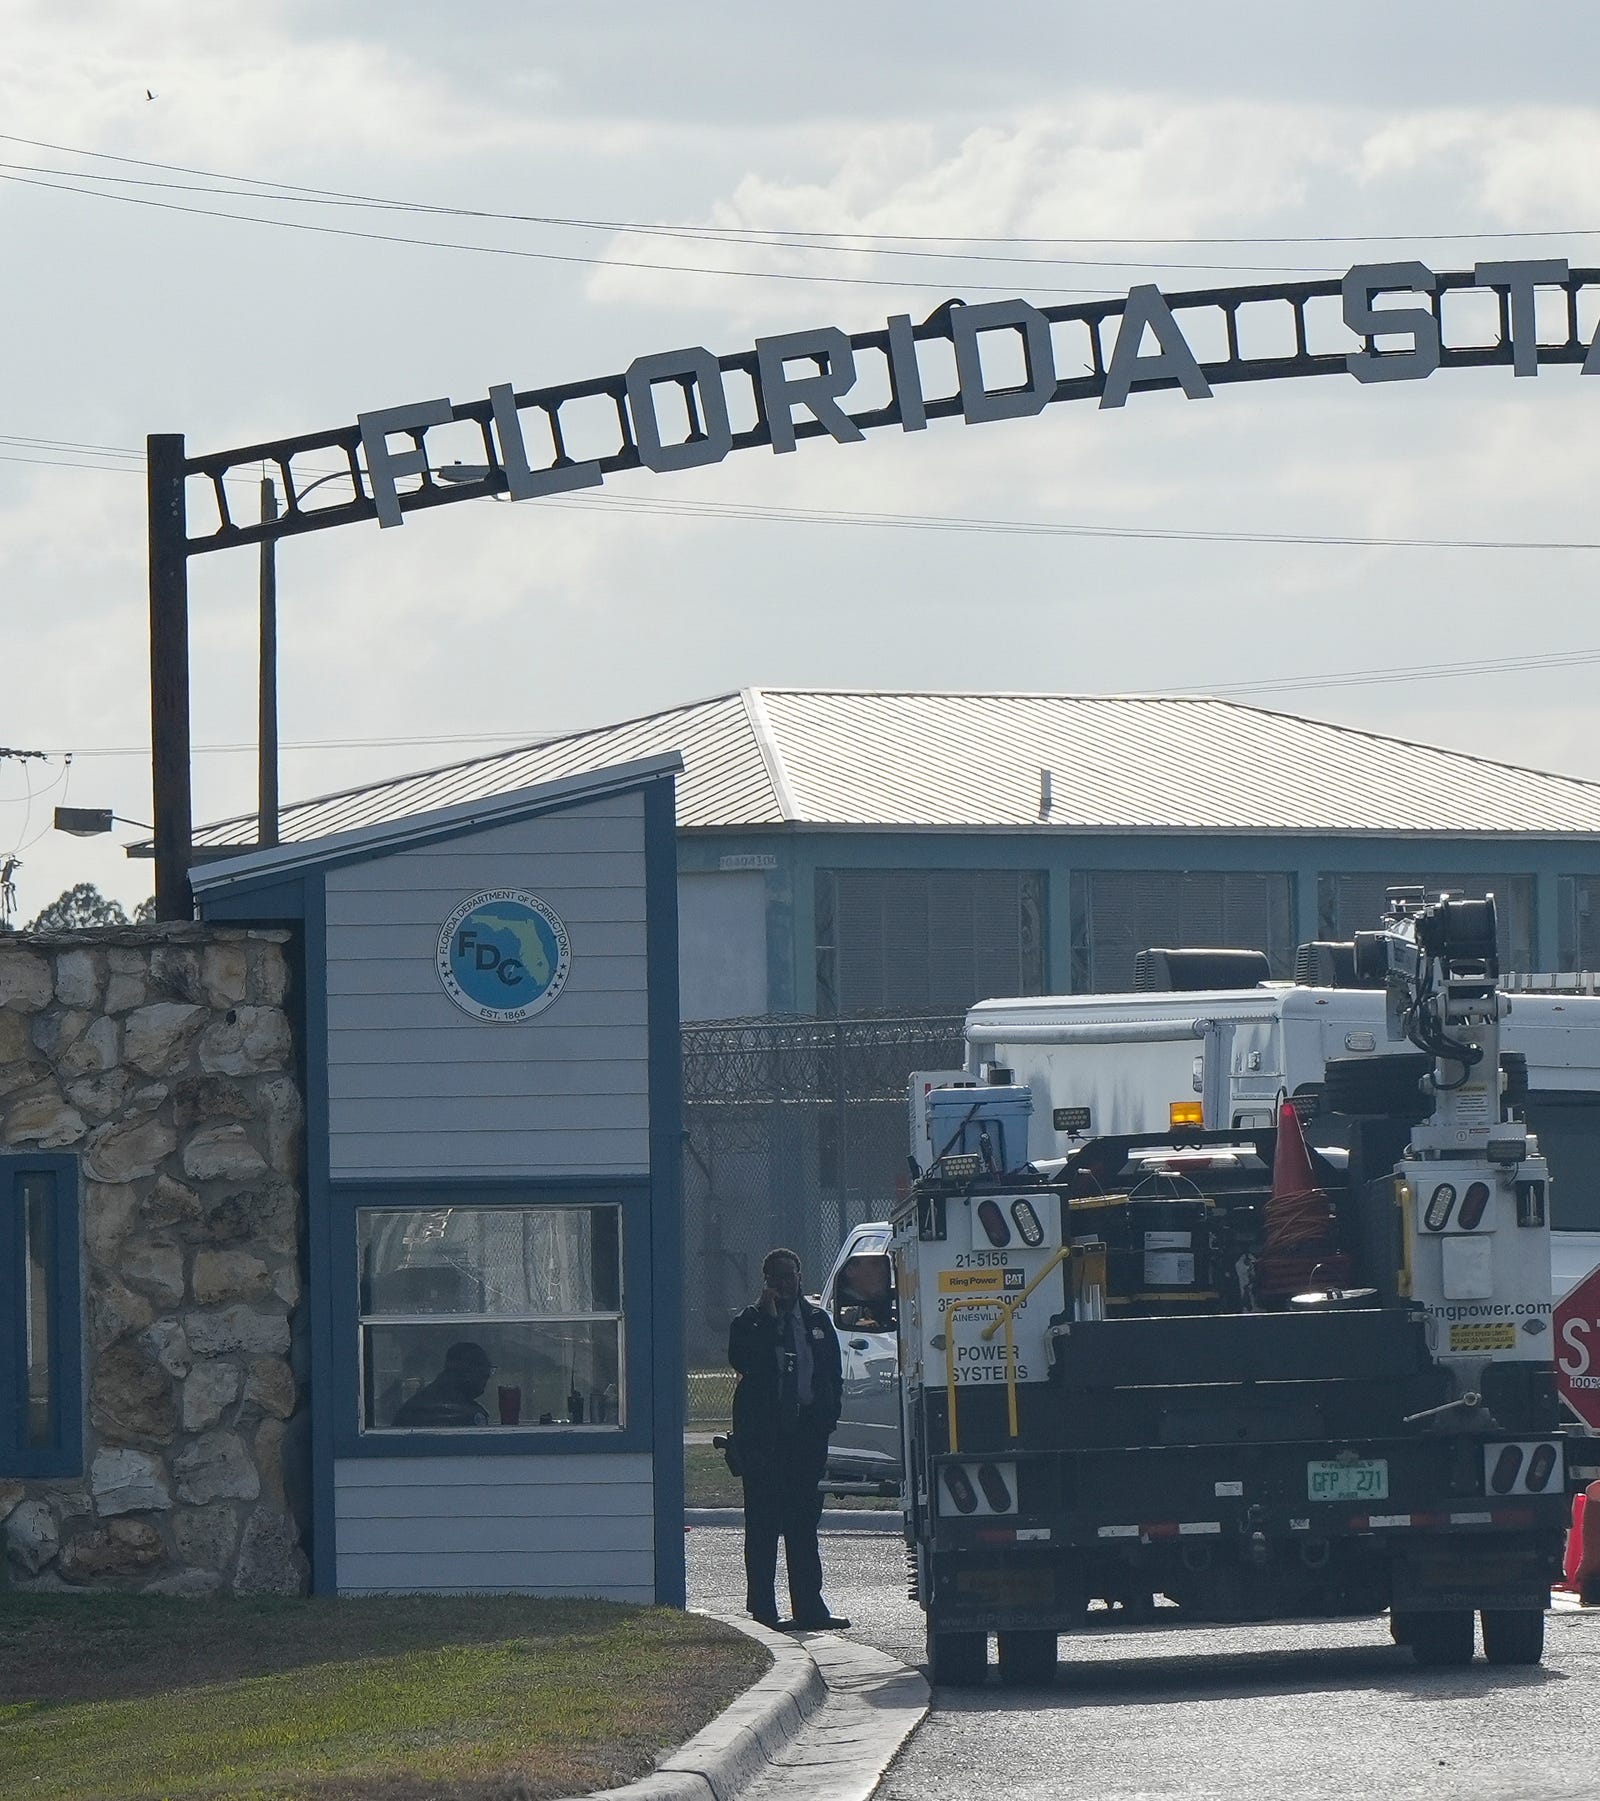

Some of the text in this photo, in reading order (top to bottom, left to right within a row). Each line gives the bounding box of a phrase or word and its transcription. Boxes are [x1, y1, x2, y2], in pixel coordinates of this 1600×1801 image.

[357, 283, 1213, 528] FLORIDA
[439, 891, 569, 957] FLORIDA DEPARTMENT OF CORRECTIONS
[458, 931, 523, 986] FDC
[480, 1008, 526, 1020] EST. 1868
[956, 1252, 1008, 1268] 21-5156
[949, 1276, 998, 1287] Ring Power
[1004, 1273, 1023, 1286] CAT
[951, 1312, 1004, 1322] AINESVILL
[958, 1345, 1019, 1361] POWER
[1356, 1470, 1381, 1491] 271
